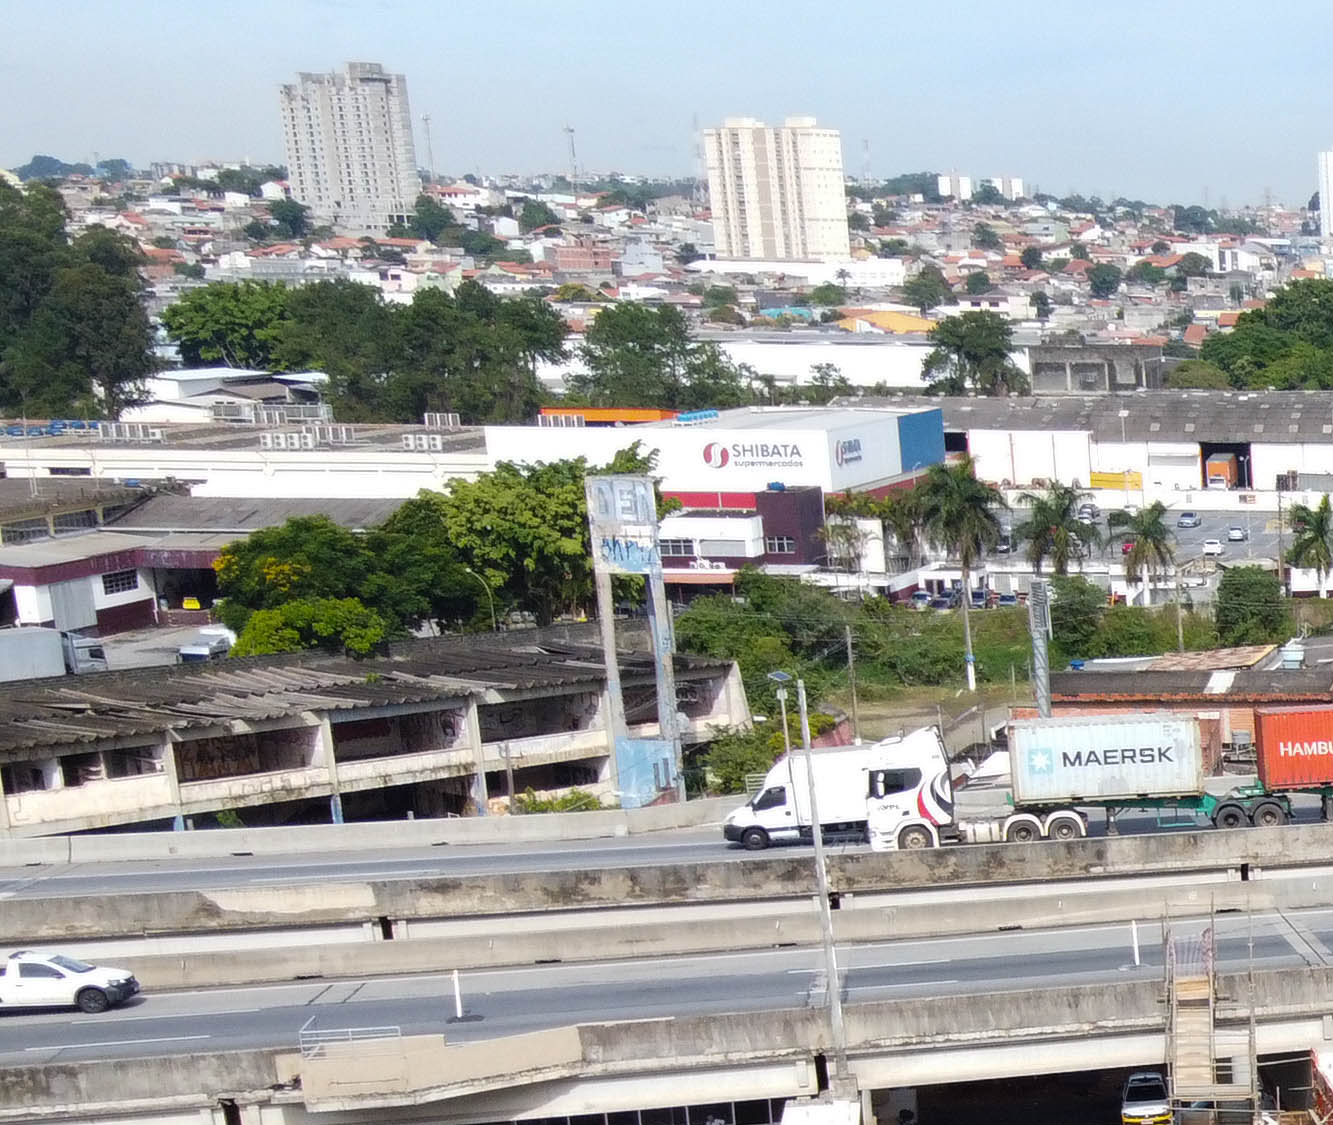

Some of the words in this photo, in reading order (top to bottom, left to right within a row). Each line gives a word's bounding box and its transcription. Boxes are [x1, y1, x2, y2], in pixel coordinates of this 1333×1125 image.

[732, 444, 802, 458] SHIBATA
[733, 459, 803, 468] supermercados
[1062, 746, 1174, 768] MAERSK
